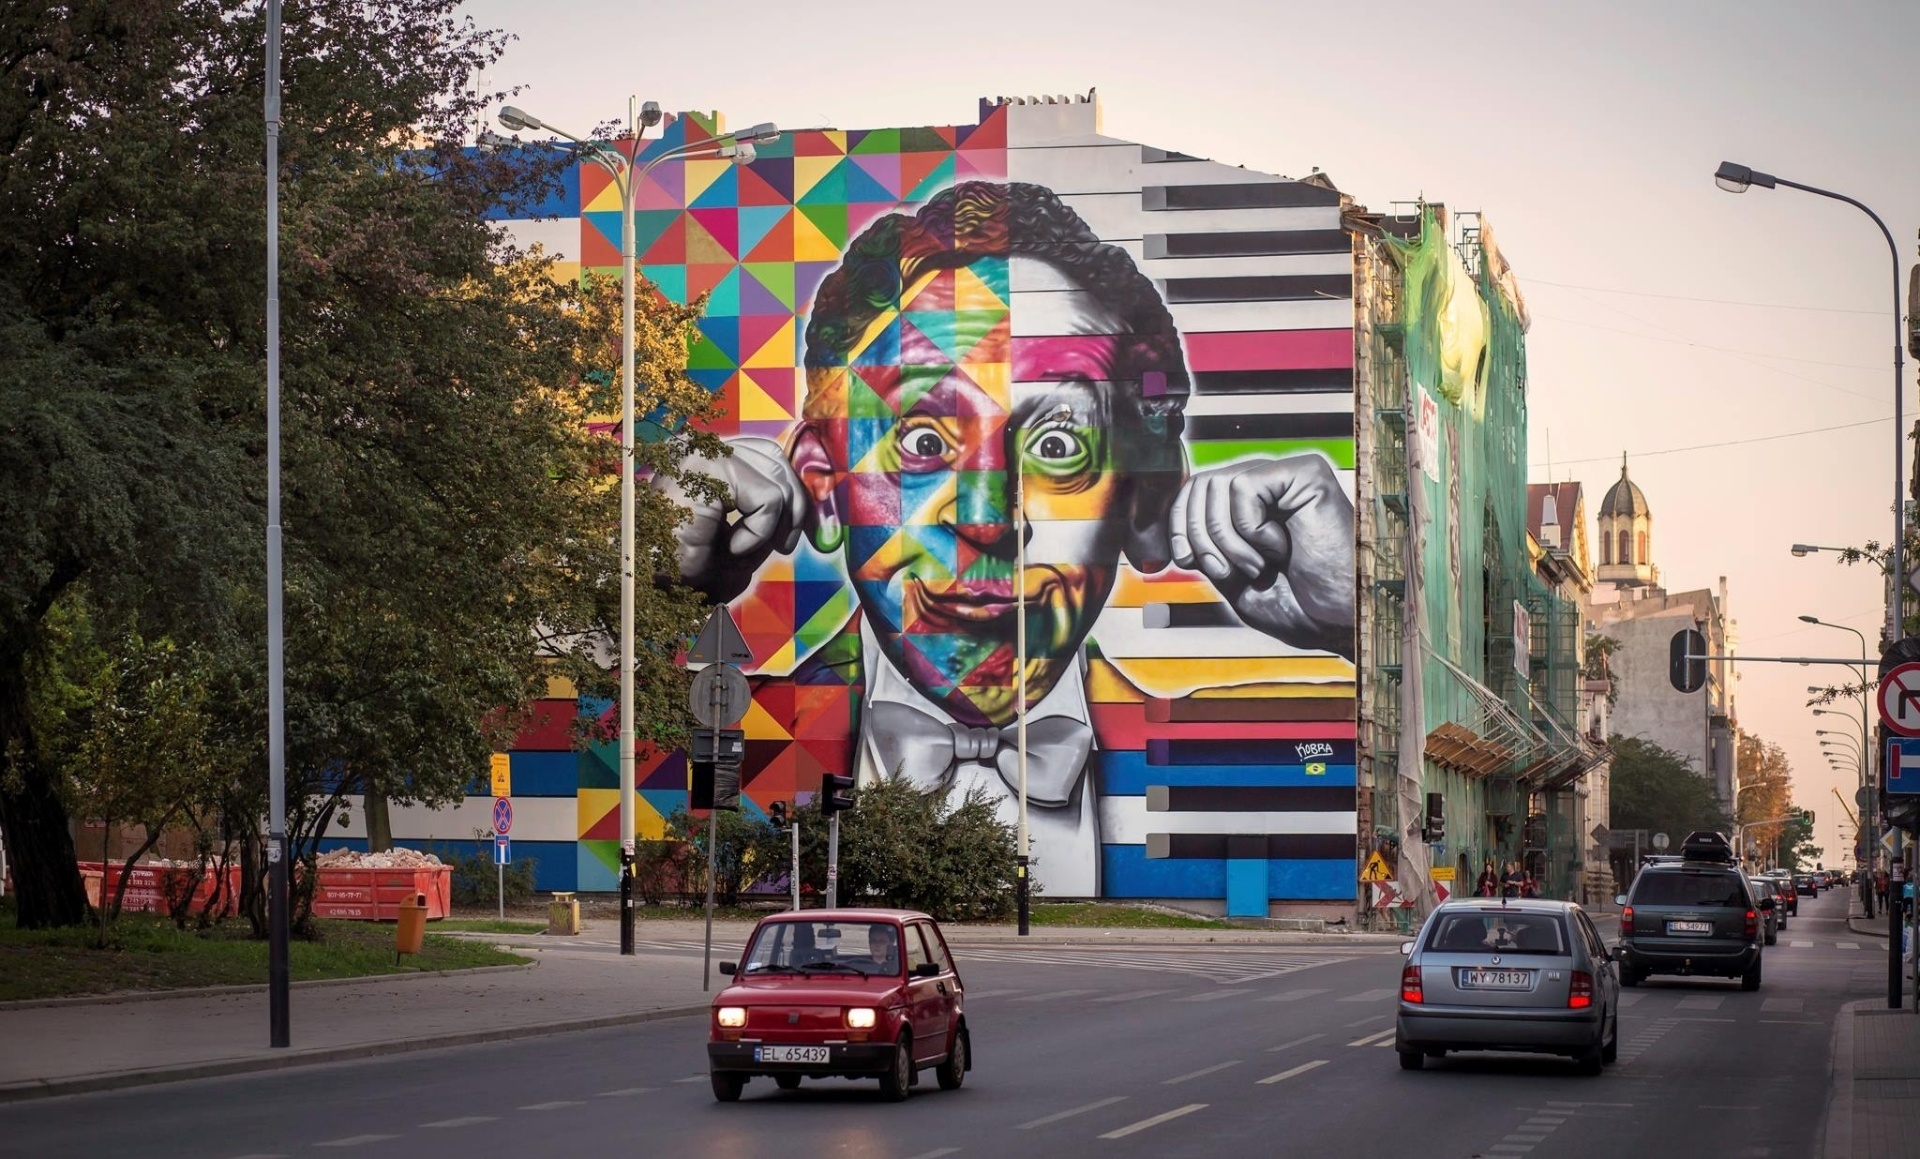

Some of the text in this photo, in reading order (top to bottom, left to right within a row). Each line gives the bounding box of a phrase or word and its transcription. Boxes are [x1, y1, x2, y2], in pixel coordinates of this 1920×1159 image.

[1295, 743, 1333, 759] KOBRA
[1674, 922, 1685, 930] EL
[1470, 972, 1528, 984] WY 78137
[762, 1047, 827, 1062] EL 65439
